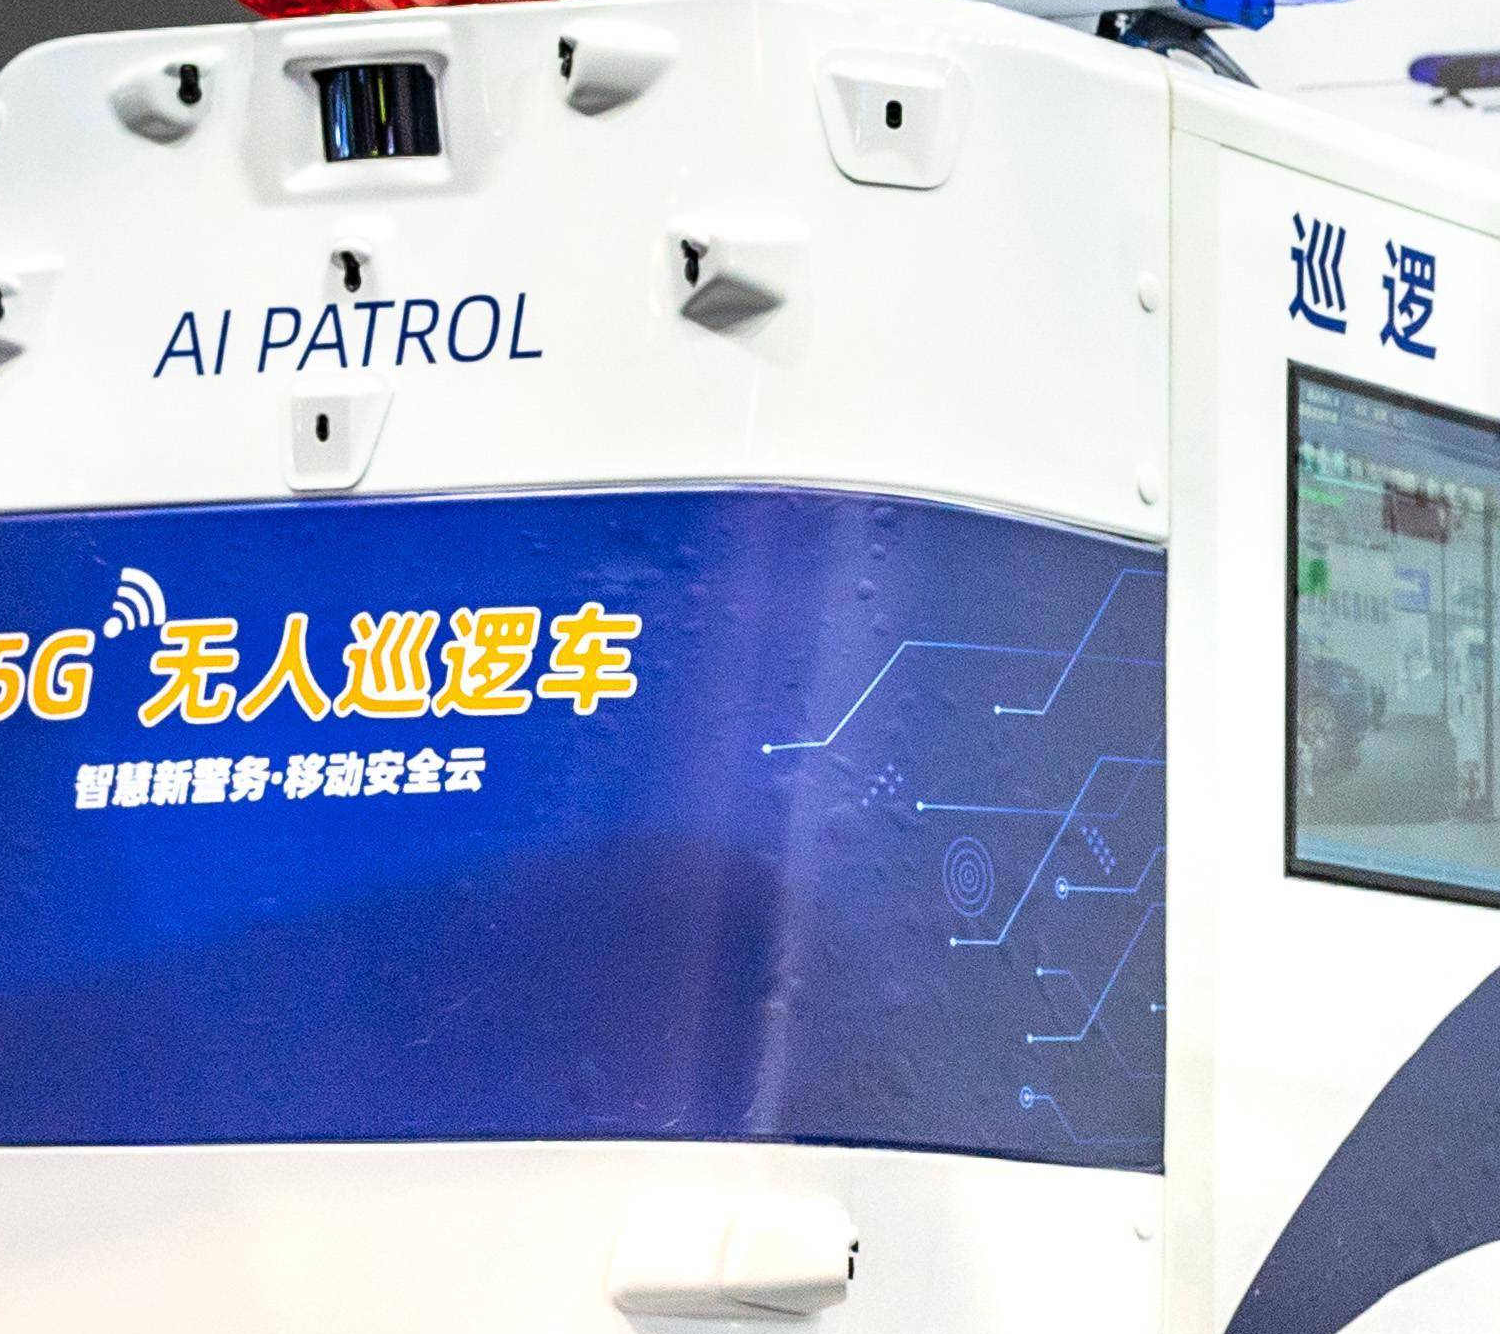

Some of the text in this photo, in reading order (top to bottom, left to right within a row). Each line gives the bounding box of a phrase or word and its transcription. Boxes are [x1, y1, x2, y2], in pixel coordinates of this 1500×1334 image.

[154, 292, 544, 378] AI PATROL
[140, 604, 642, 727] 无人巡逻车
